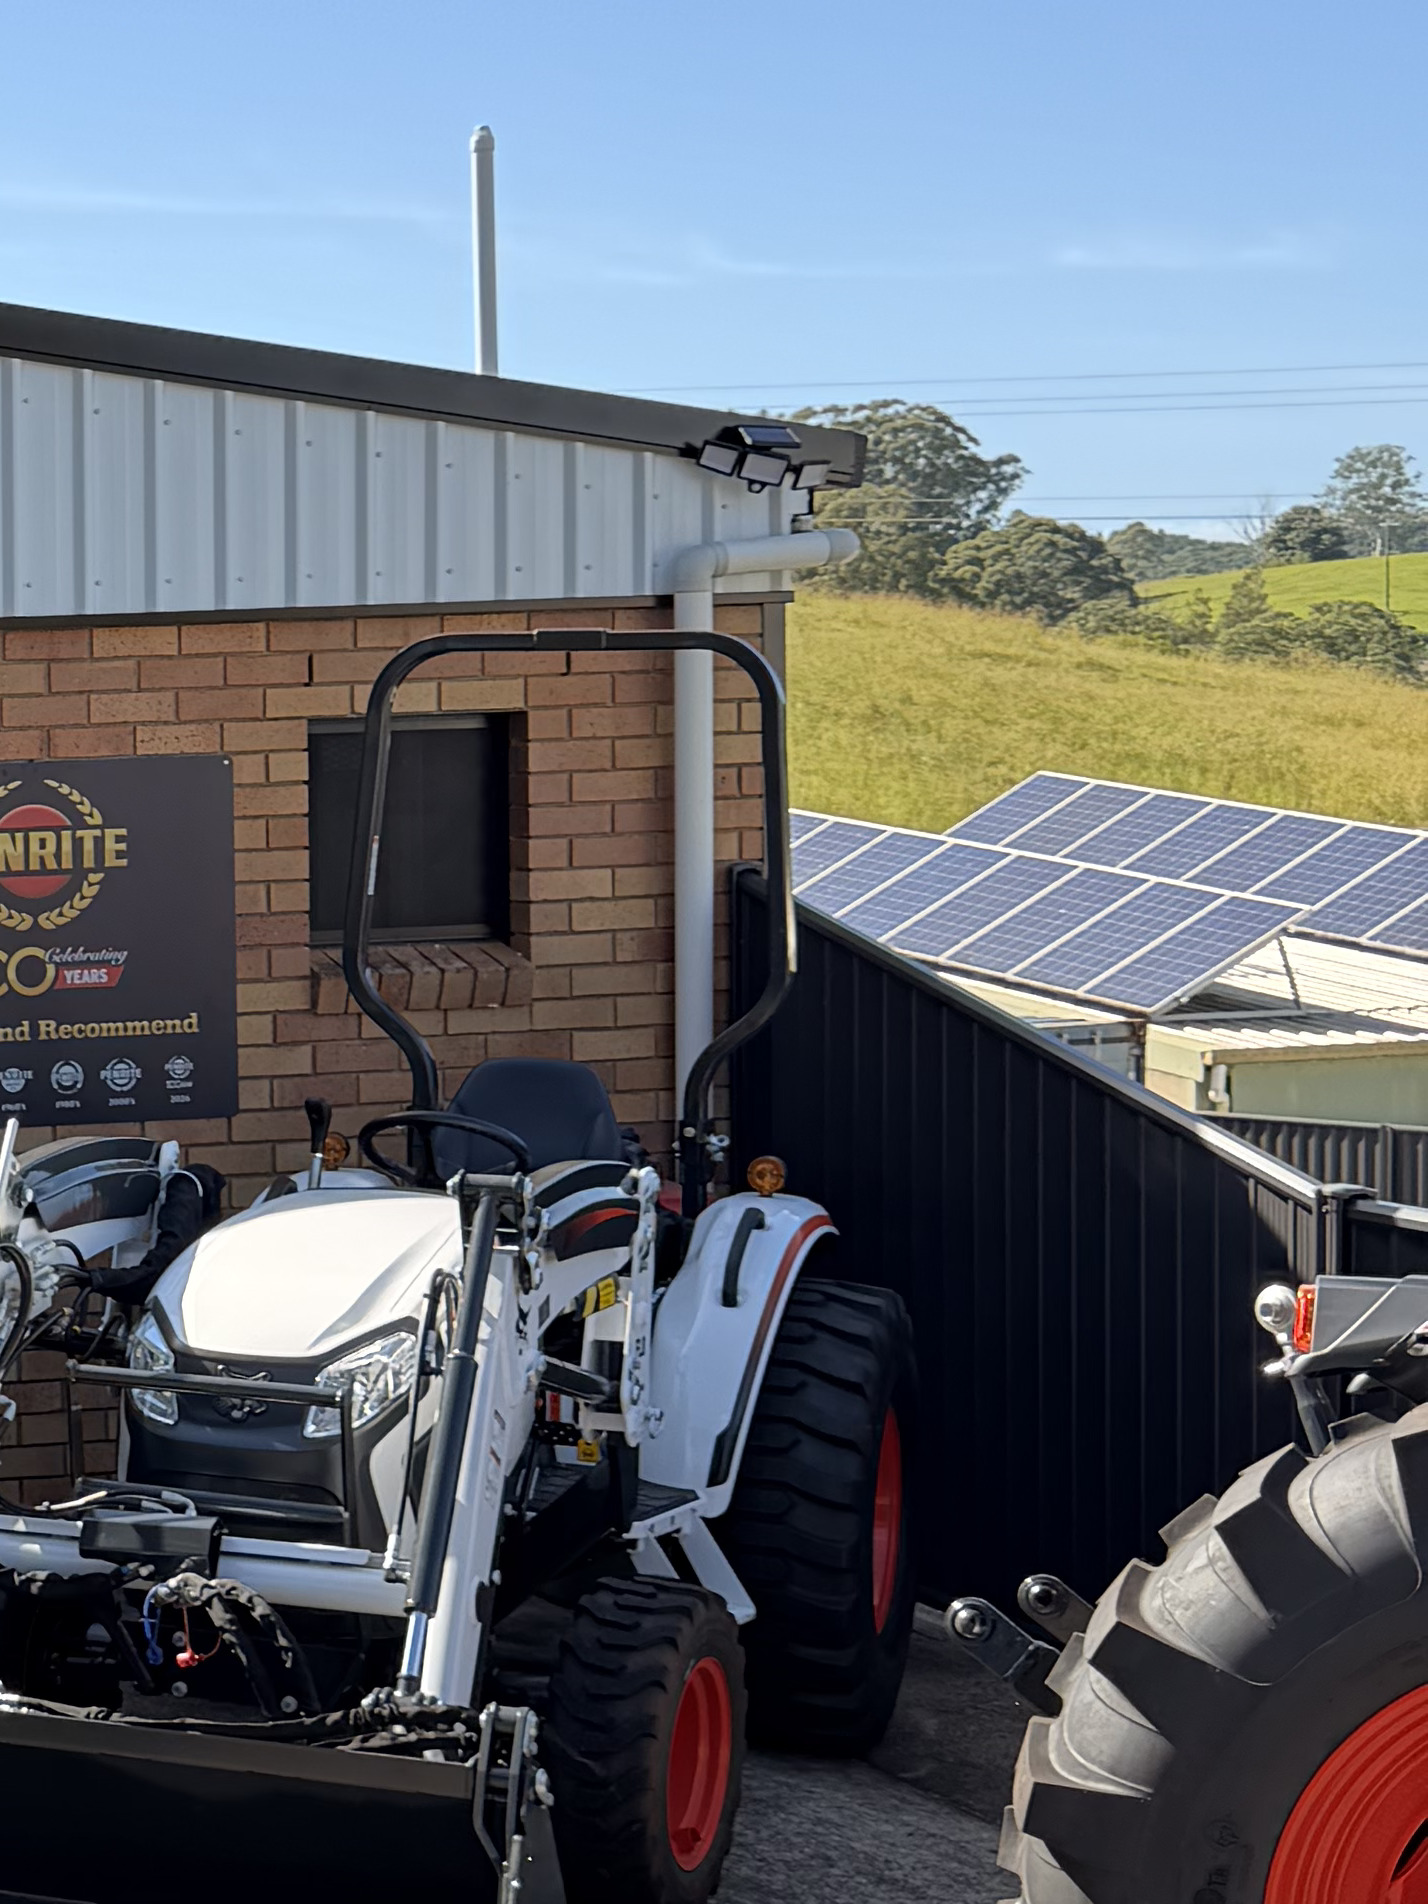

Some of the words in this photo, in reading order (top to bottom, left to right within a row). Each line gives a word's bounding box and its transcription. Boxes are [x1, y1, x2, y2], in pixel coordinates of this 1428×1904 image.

[44, 946, 128, 965] Celebrating
[64, 969, 109, 984] YEARS
[38, 1013, 200, 1040] Recommend
